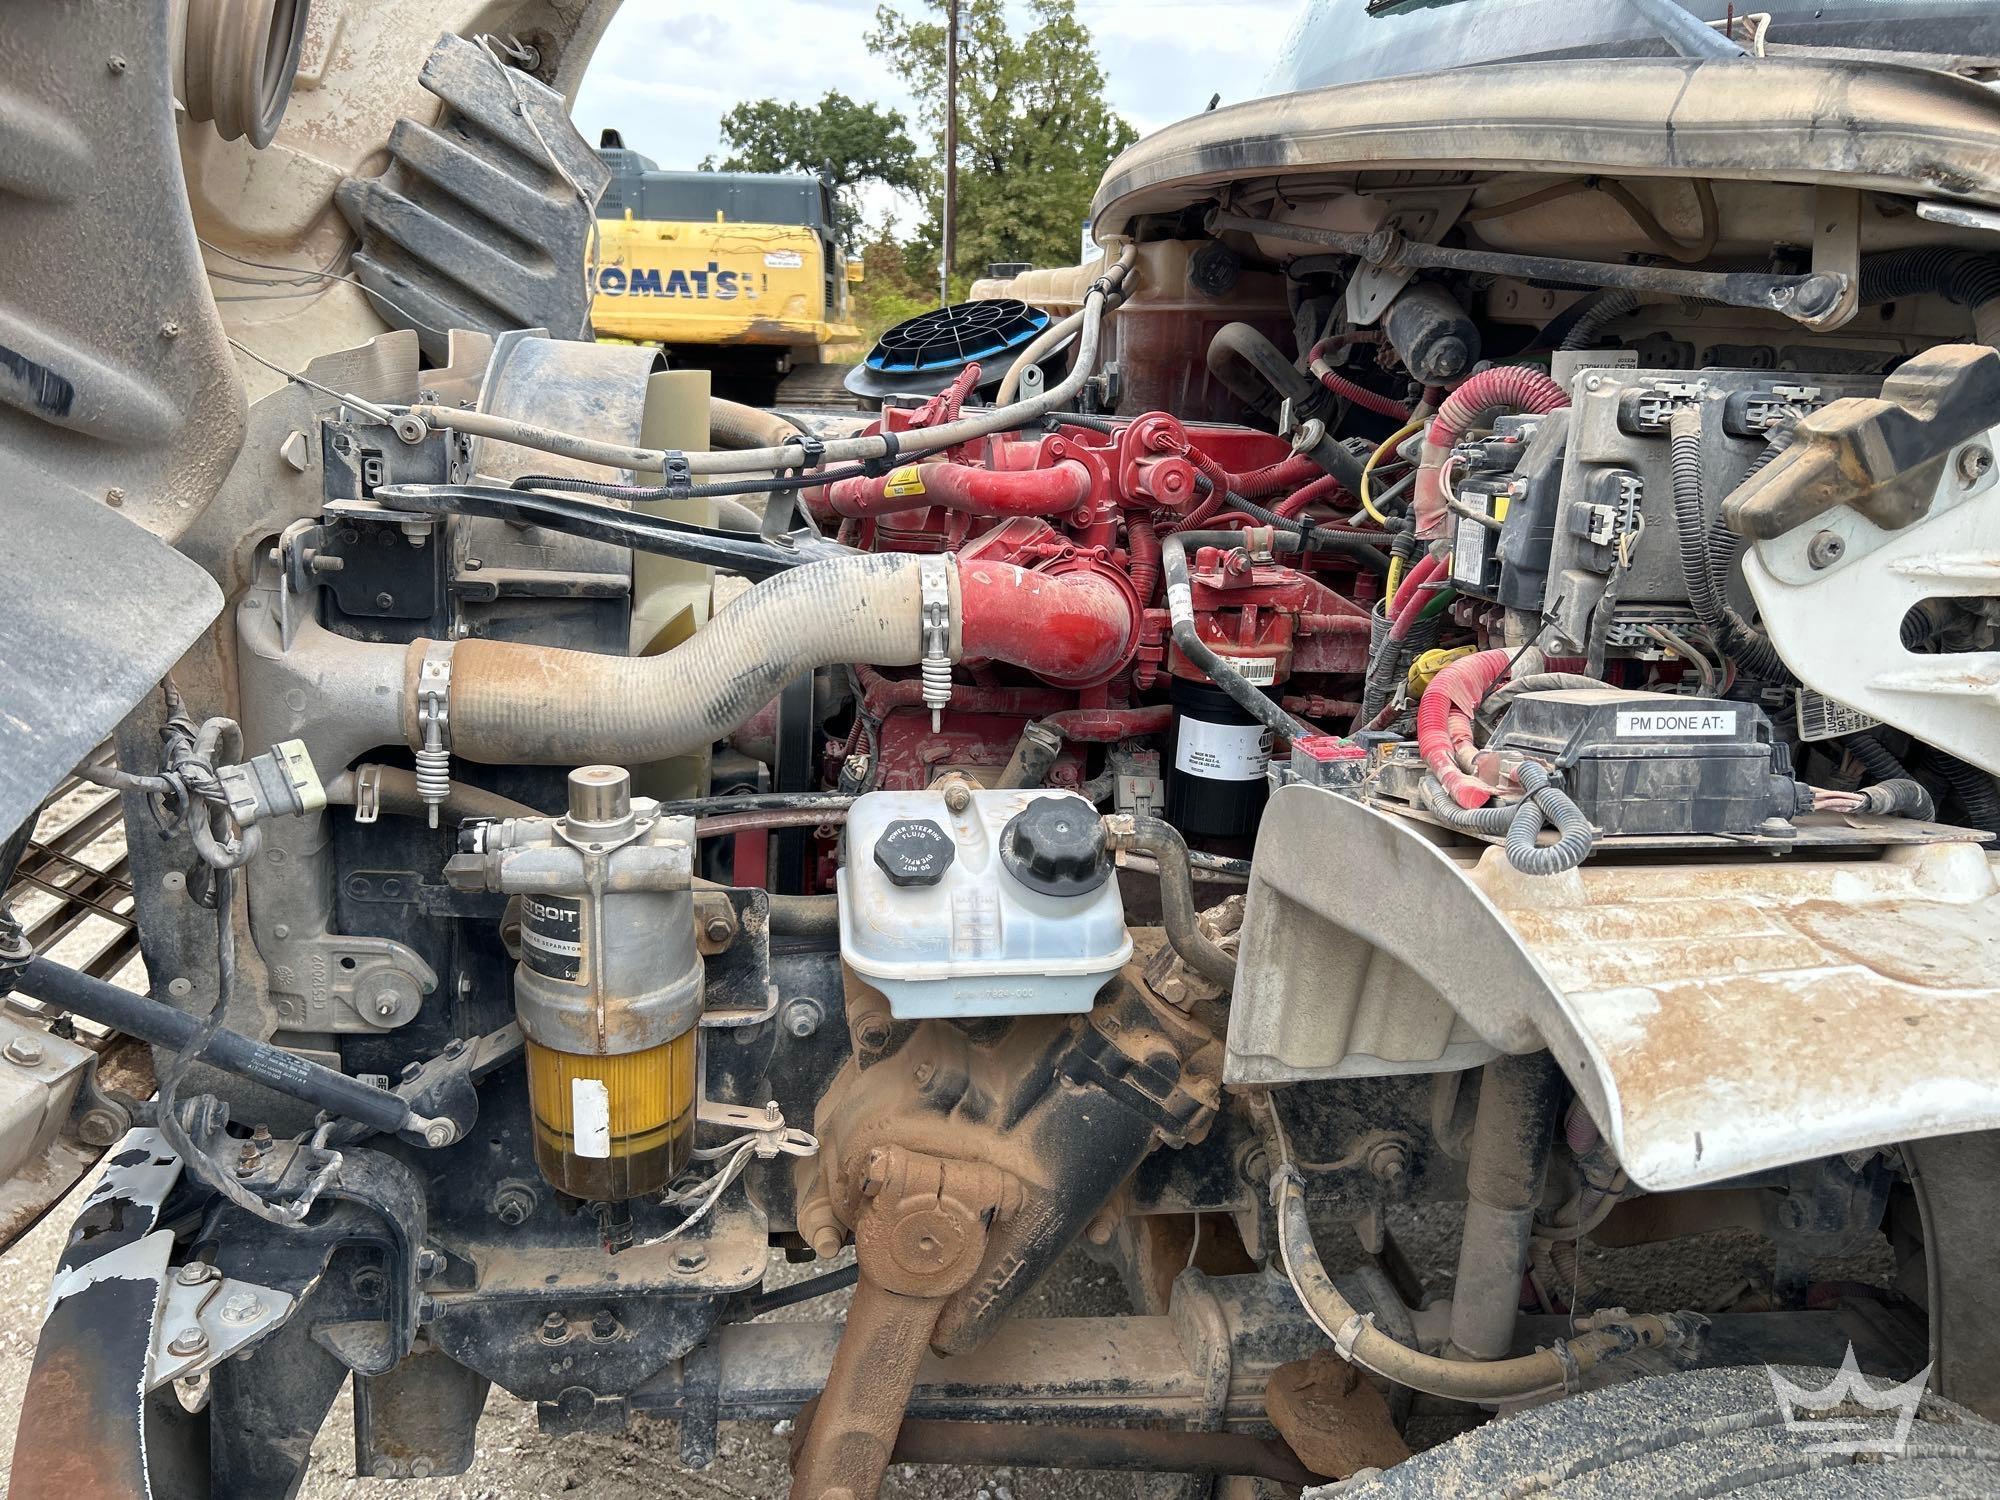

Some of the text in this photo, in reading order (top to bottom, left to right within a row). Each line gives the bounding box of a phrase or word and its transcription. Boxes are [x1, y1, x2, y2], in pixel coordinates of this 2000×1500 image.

[588, 262, 757, 300] OMATS
[1630, 716, 1724, 730] PM DONE AT:
[887, 824, 942, 843] POWER STEERING
[901, 831, 926, 840] FLUID
[899, 853, 934, 866] OVERFILL
[902, 863, 931, 872] DO NOT
